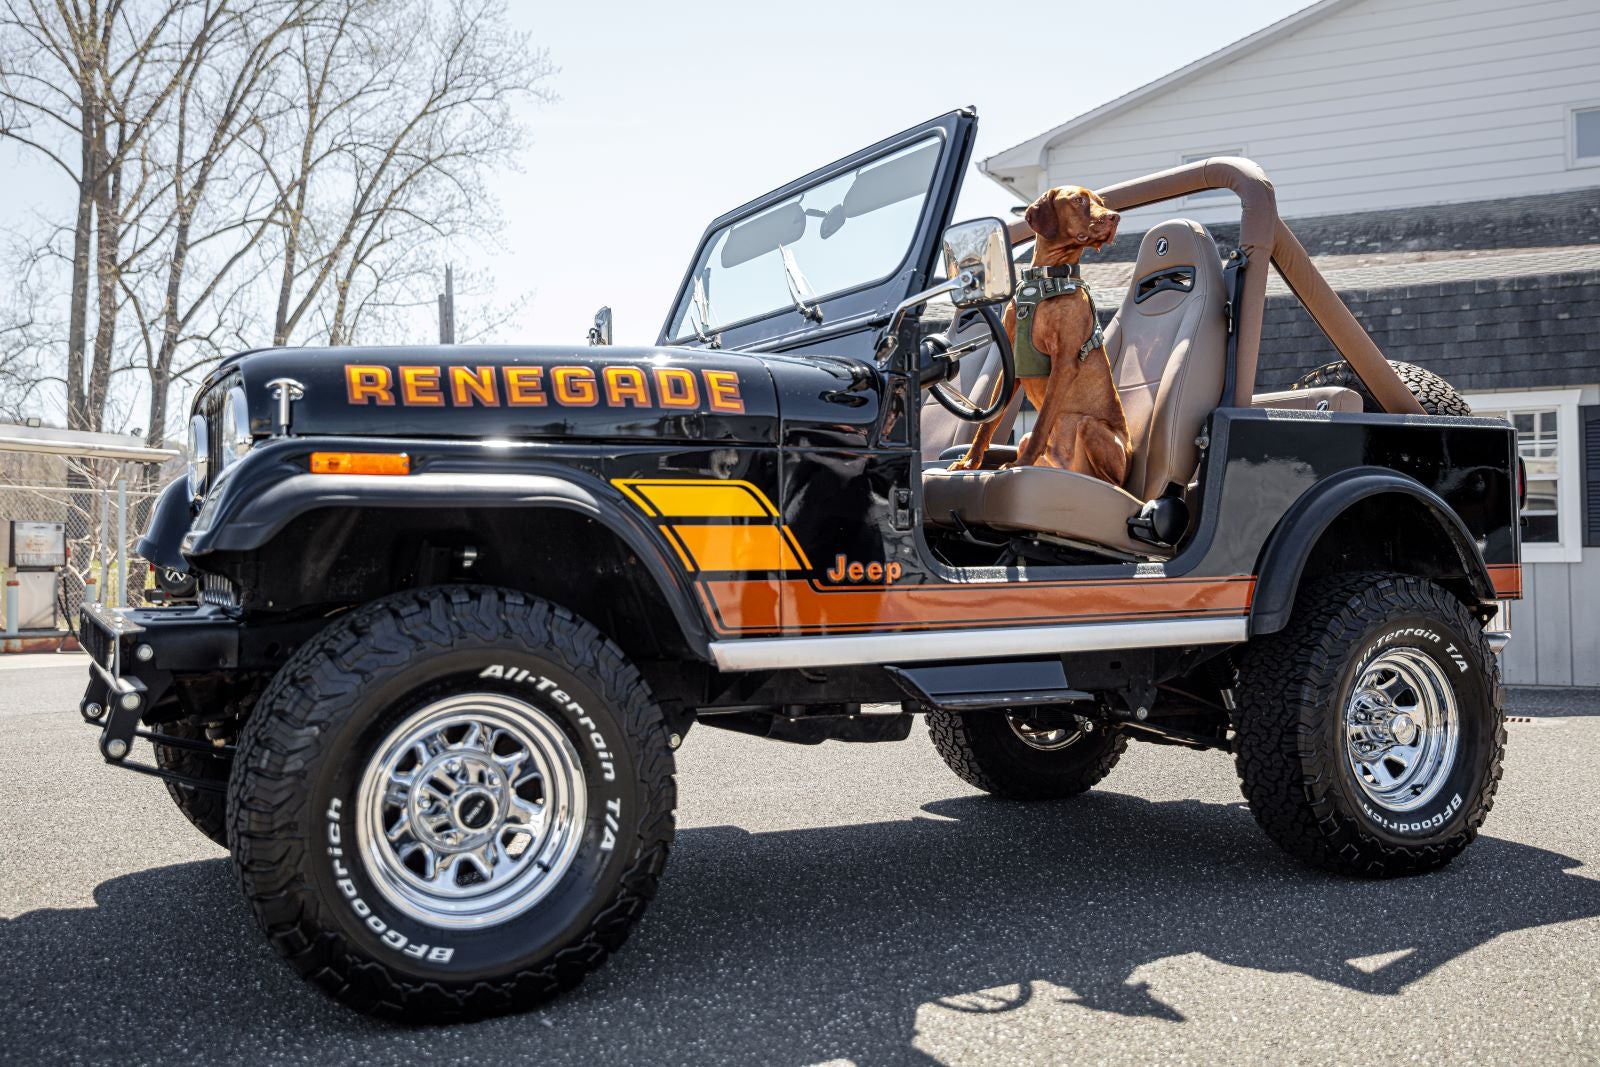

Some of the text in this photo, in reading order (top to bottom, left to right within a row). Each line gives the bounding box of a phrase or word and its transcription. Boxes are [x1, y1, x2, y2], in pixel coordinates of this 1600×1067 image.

[344, 364, 747, 414] RENEGADE
[827, 553, 903, 585] Jeep
[1355, 628, 1469, 675] All-Terrain T/A
[479, 664, 621, 850] All-Terrain T/A
[1363, 793, 1462, 832] BFGoodrich
[326, 798, 454, 963] BFGoodrich
